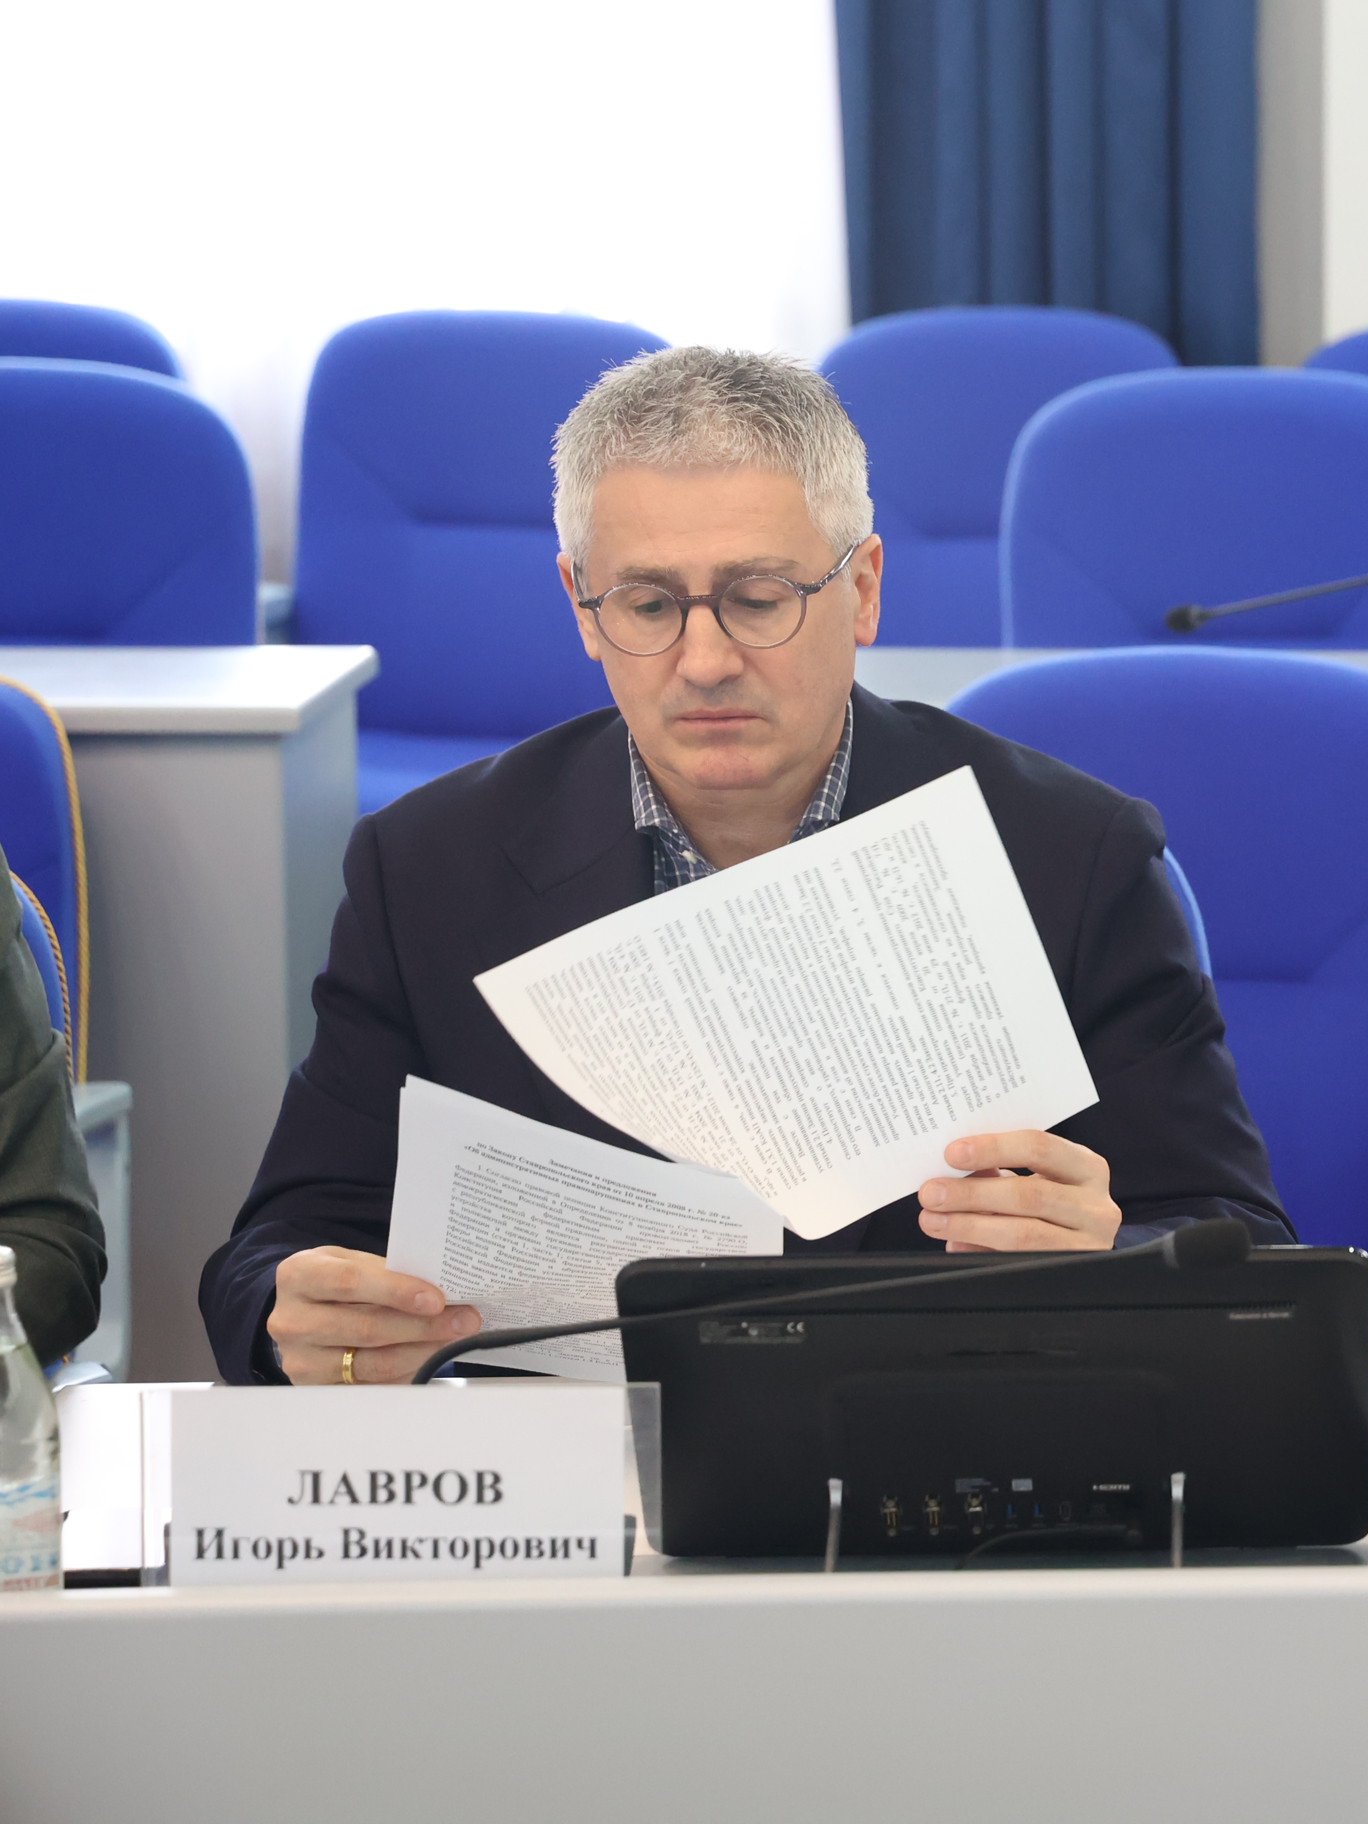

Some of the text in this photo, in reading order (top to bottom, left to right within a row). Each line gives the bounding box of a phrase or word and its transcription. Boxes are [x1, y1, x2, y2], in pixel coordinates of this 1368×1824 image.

[287, 1468, 505, 1506] ЛАВРОВ
[192, 1526, 599, 1570] Игорь Викторович
